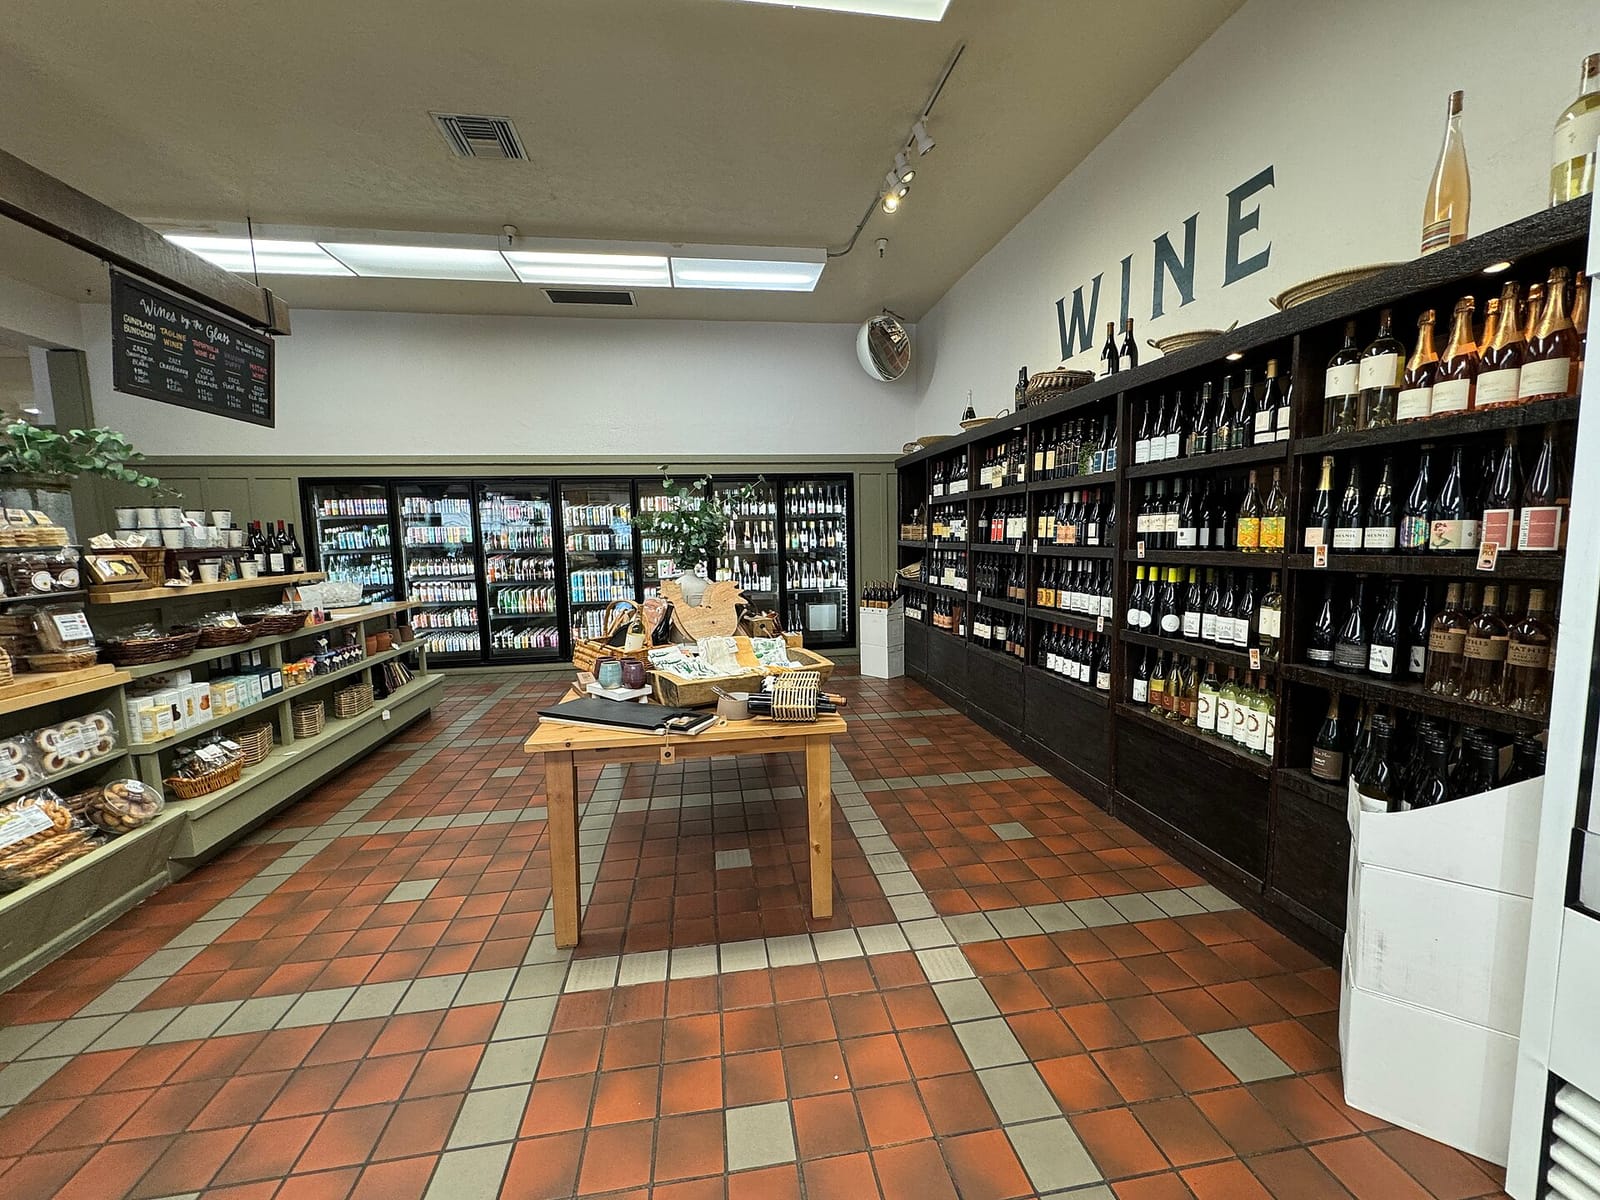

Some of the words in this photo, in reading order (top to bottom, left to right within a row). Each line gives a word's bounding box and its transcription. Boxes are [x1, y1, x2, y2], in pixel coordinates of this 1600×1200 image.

[140, 299, 176, 323] Wines
[181, 314, 191, 330] by
[205, 324, 231, 345] Glass
[1055, 165, 1275, 361] WINE
